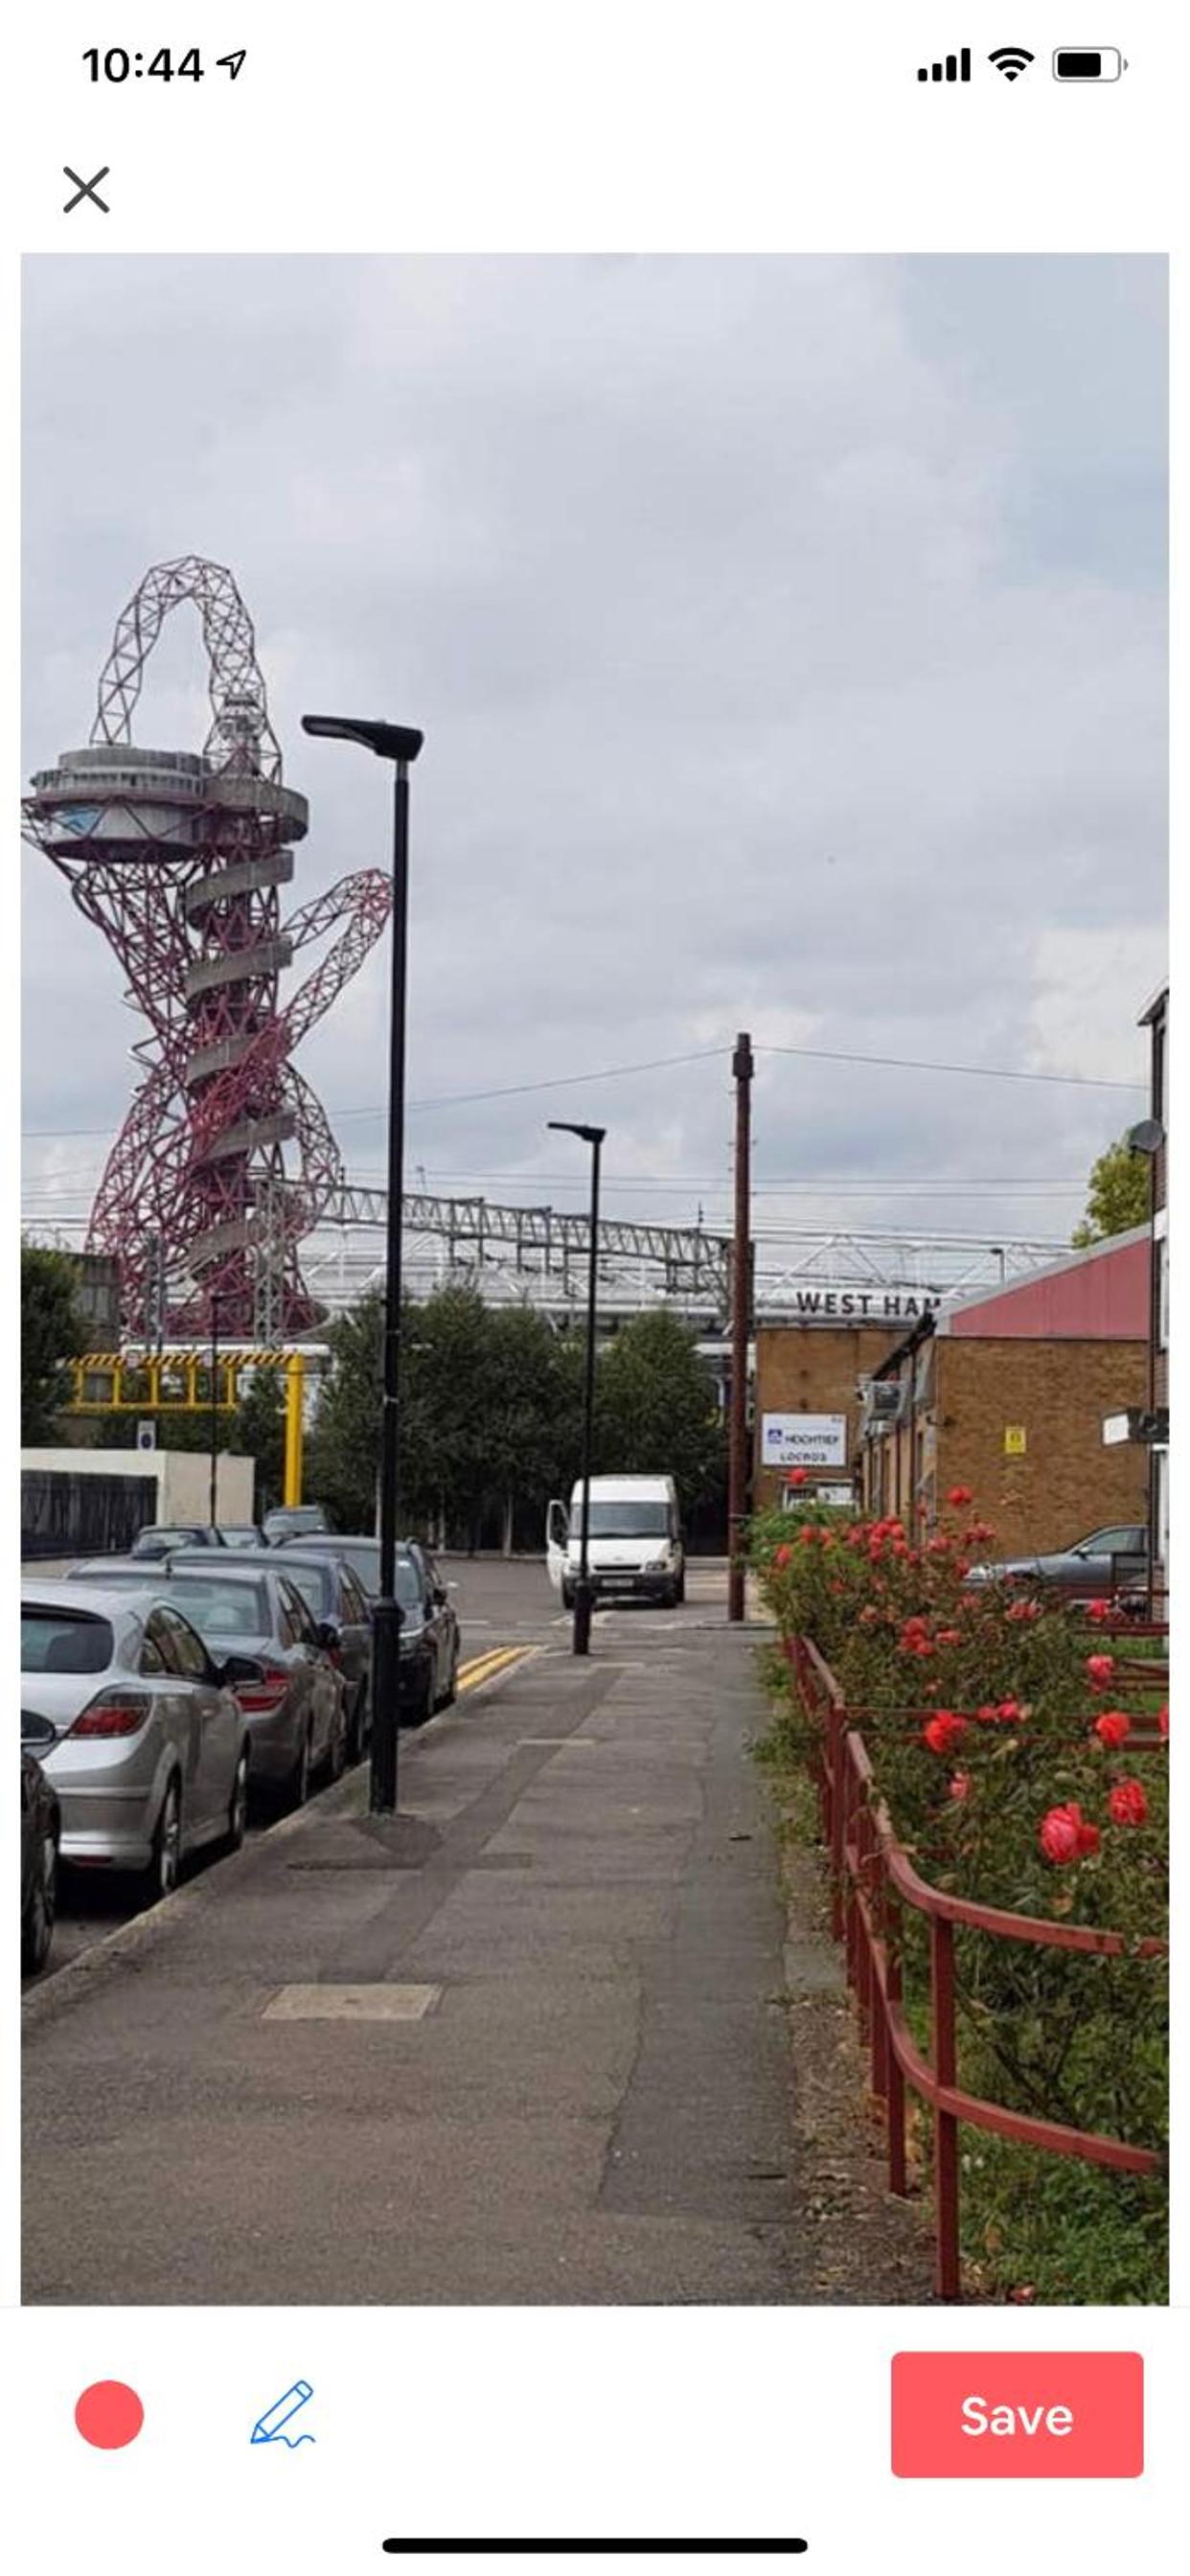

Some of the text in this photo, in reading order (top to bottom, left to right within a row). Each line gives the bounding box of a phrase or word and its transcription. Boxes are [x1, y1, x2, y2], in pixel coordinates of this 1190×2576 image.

[796, 1291, 942, 1316] WEST HAM
[785, 1435, 839, 1445] HOCHTIEF
